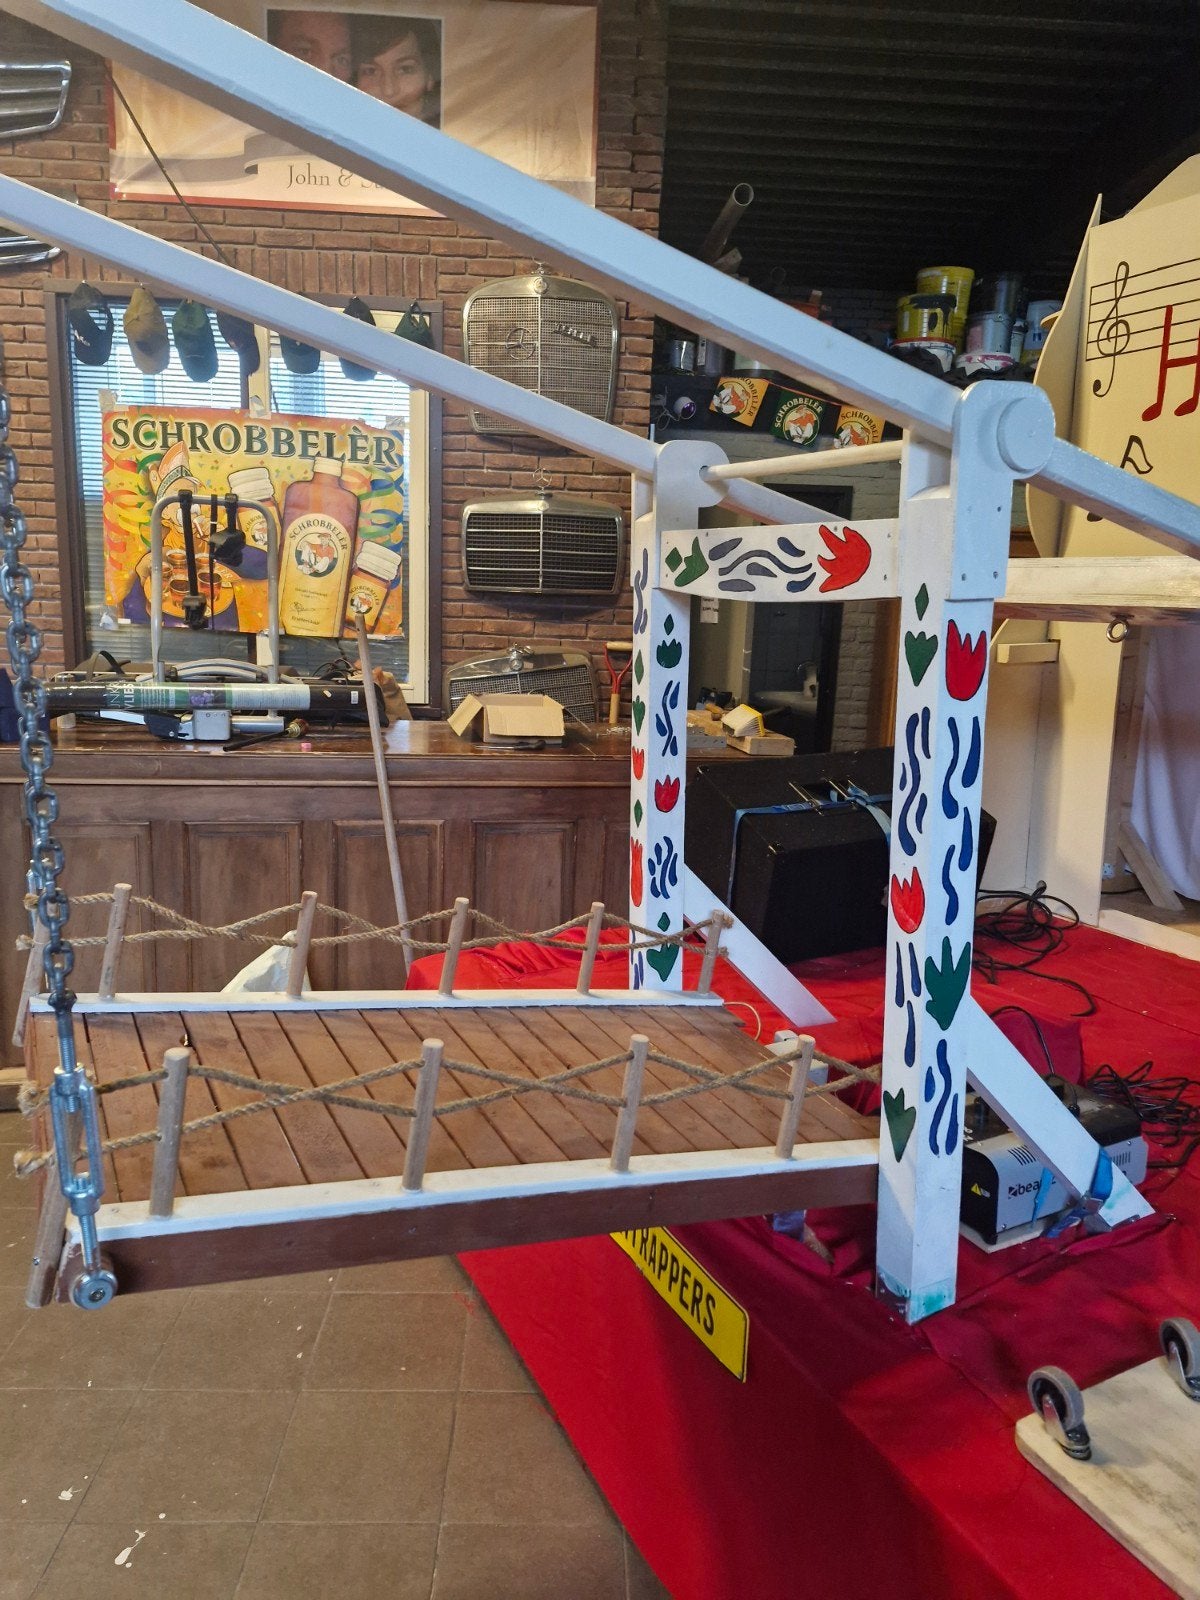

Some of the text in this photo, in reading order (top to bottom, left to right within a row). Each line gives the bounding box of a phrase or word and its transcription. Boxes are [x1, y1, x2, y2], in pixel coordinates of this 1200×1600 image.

[287, 163, 353, 189] John &
[111, 418, 397, 467] SCHROBBELÈR
[840, 410, 879, 443] SCHROBBEL
[621, 1228, 716, 1336] RAPPERS
